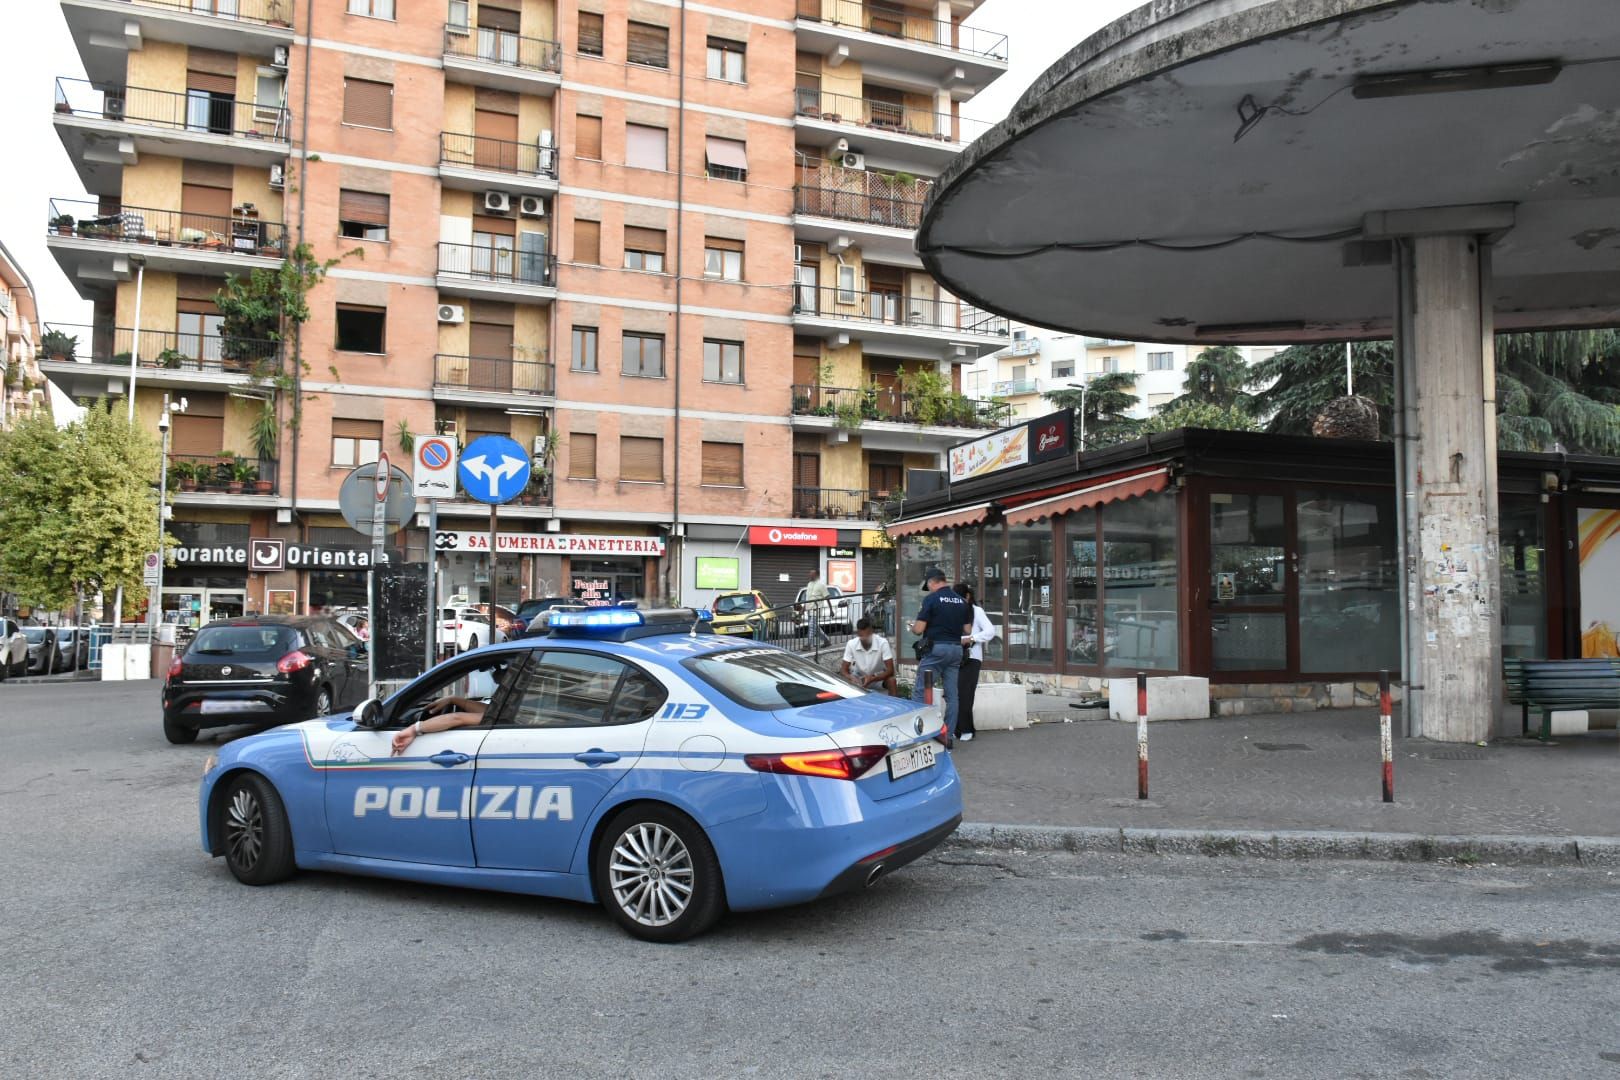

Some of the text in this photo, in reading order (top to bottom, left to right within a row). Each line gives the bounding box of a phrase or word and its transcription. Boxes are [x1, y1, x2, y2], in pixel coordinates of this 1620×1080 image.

[468, 535, 555, 550] SAUMERIA
[569, 538, 659, 552] PANETTERIA
[783, 532, 818, 541] vodafone
[172, 546, 247, 563] orante
[661, 702, 710, 720] 113
[353, 785, 574, 821] POLIZIA
